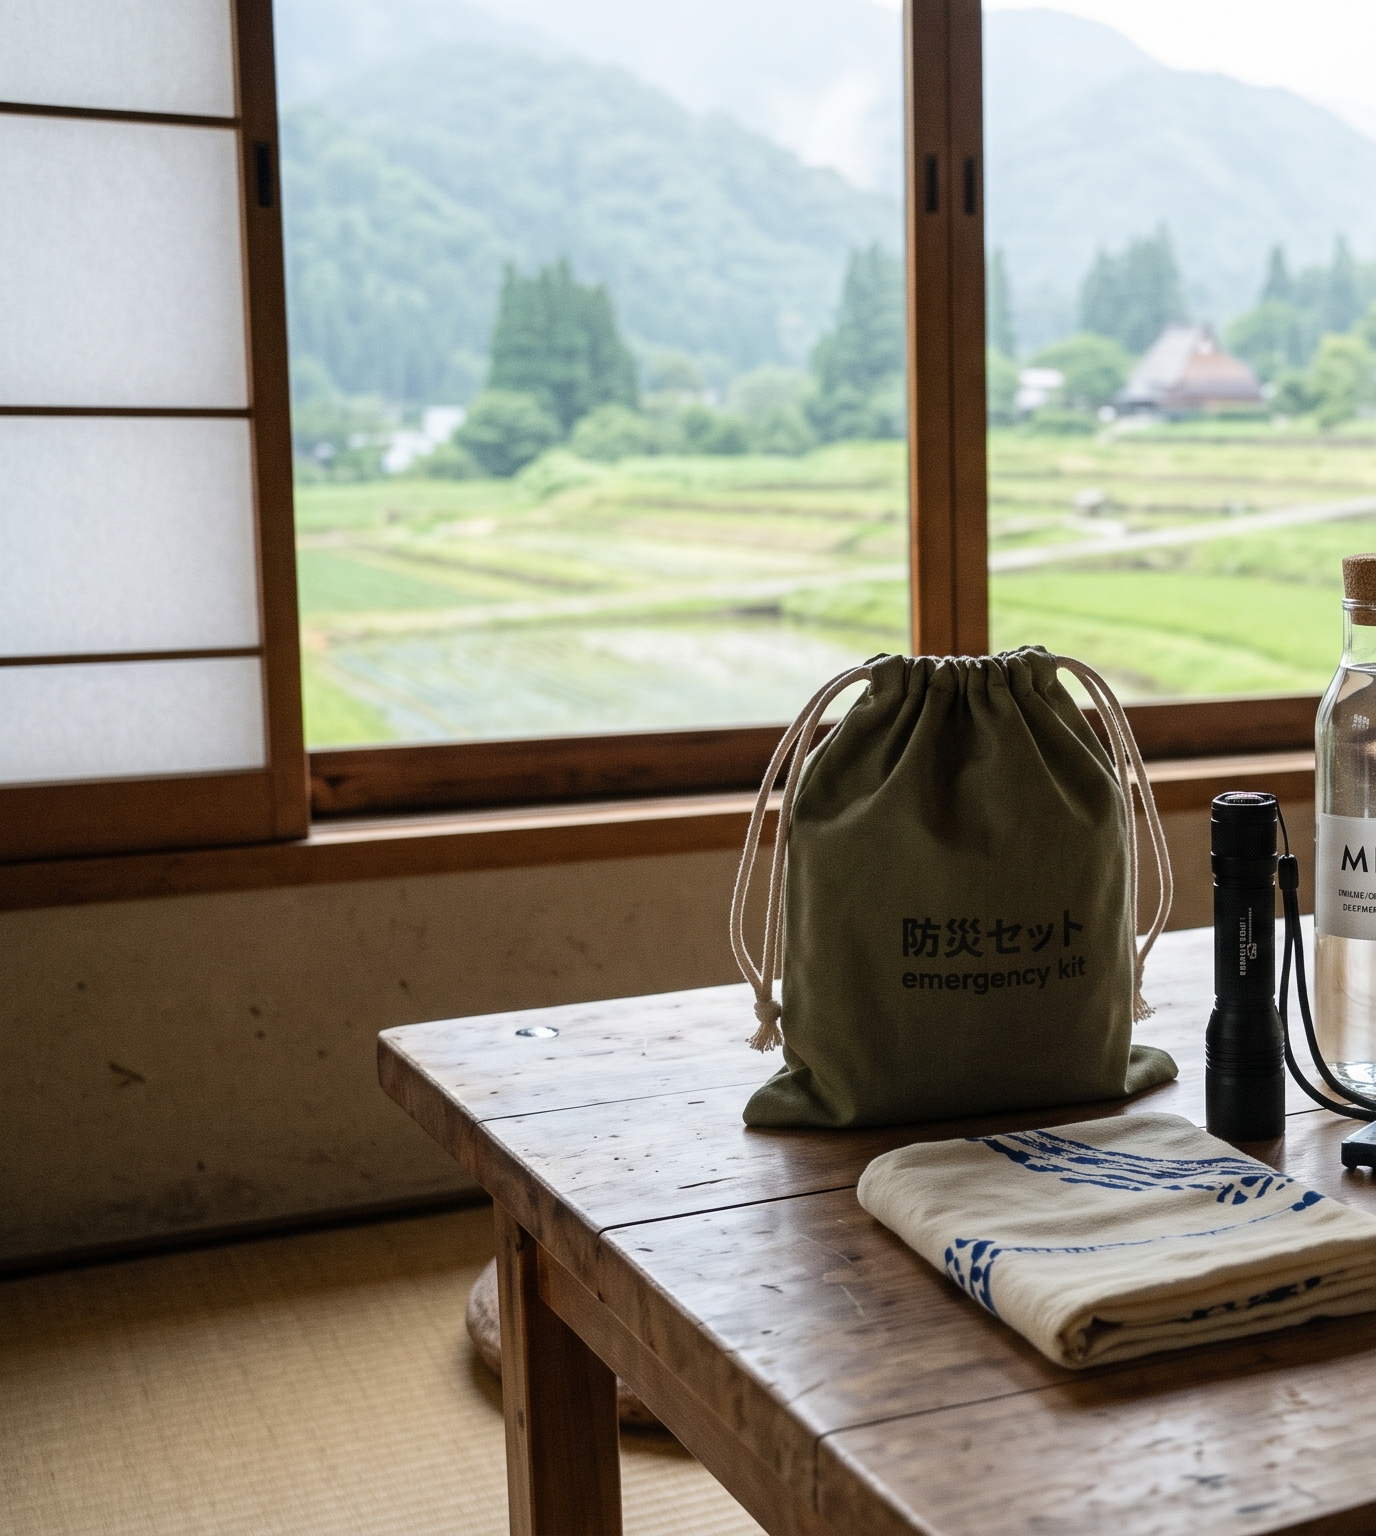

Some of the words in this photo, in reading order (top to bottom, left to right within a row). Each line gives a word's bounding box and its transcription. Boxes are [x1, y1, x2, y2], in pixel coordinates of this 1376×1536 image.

[902, 909, 1084, 958] 防災セット
[902, 966, 1050, 994] emergency
[1058, 955, 1086, 980] kit
